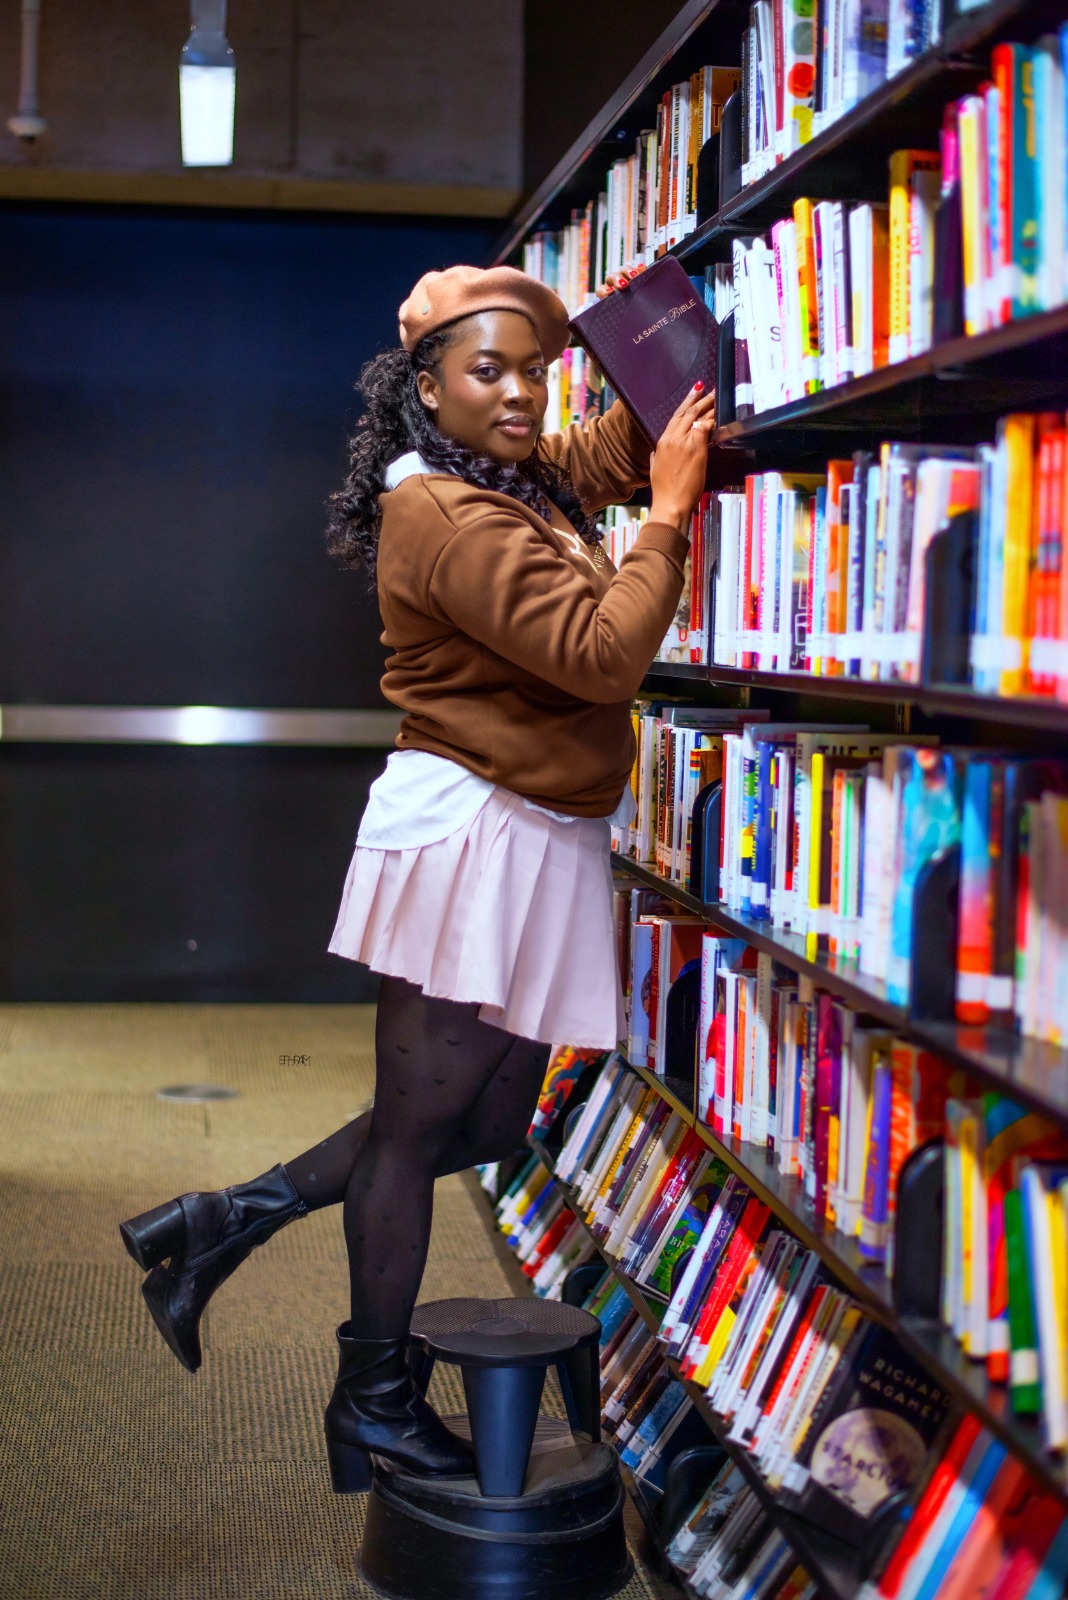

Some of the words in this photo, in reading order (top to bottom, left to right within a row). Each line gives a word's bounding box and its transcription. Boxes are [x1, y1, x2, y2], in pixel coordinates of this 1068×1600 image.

[633, 334, 644, 344] LA
[643, 317, 669, 338] SAINTE
[667, 298, 696, 321] BIBLE
[593, 546, 606, 568] VIBES
[874, 1358, 952, 1407] RICHARD
